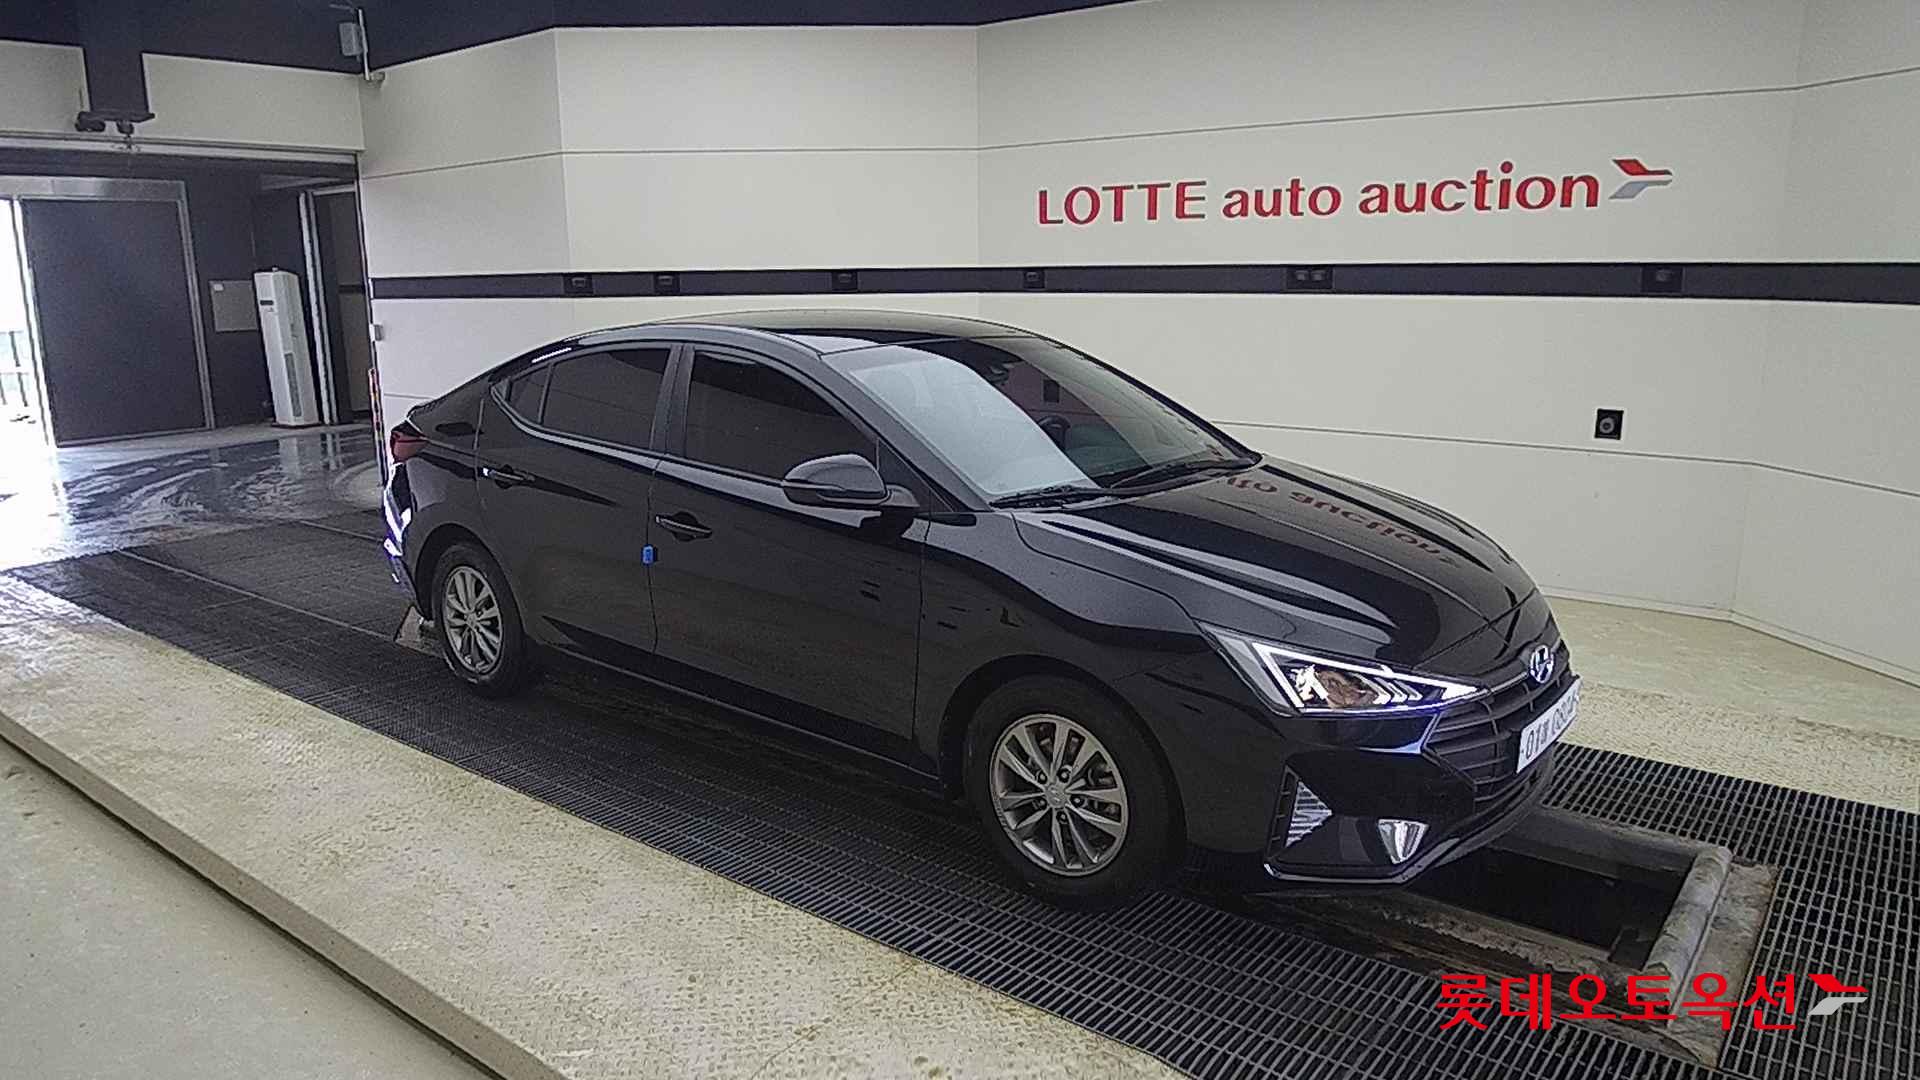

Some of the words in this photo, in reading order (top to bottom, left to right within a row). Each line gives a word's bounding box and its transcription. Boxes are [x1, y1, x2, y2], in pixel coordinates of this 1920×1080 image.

[1038, 180, 1208, 225] LOTTE
[1222, 178, 1341, 218] auto
[1358, 160, 1600, 214] auction
